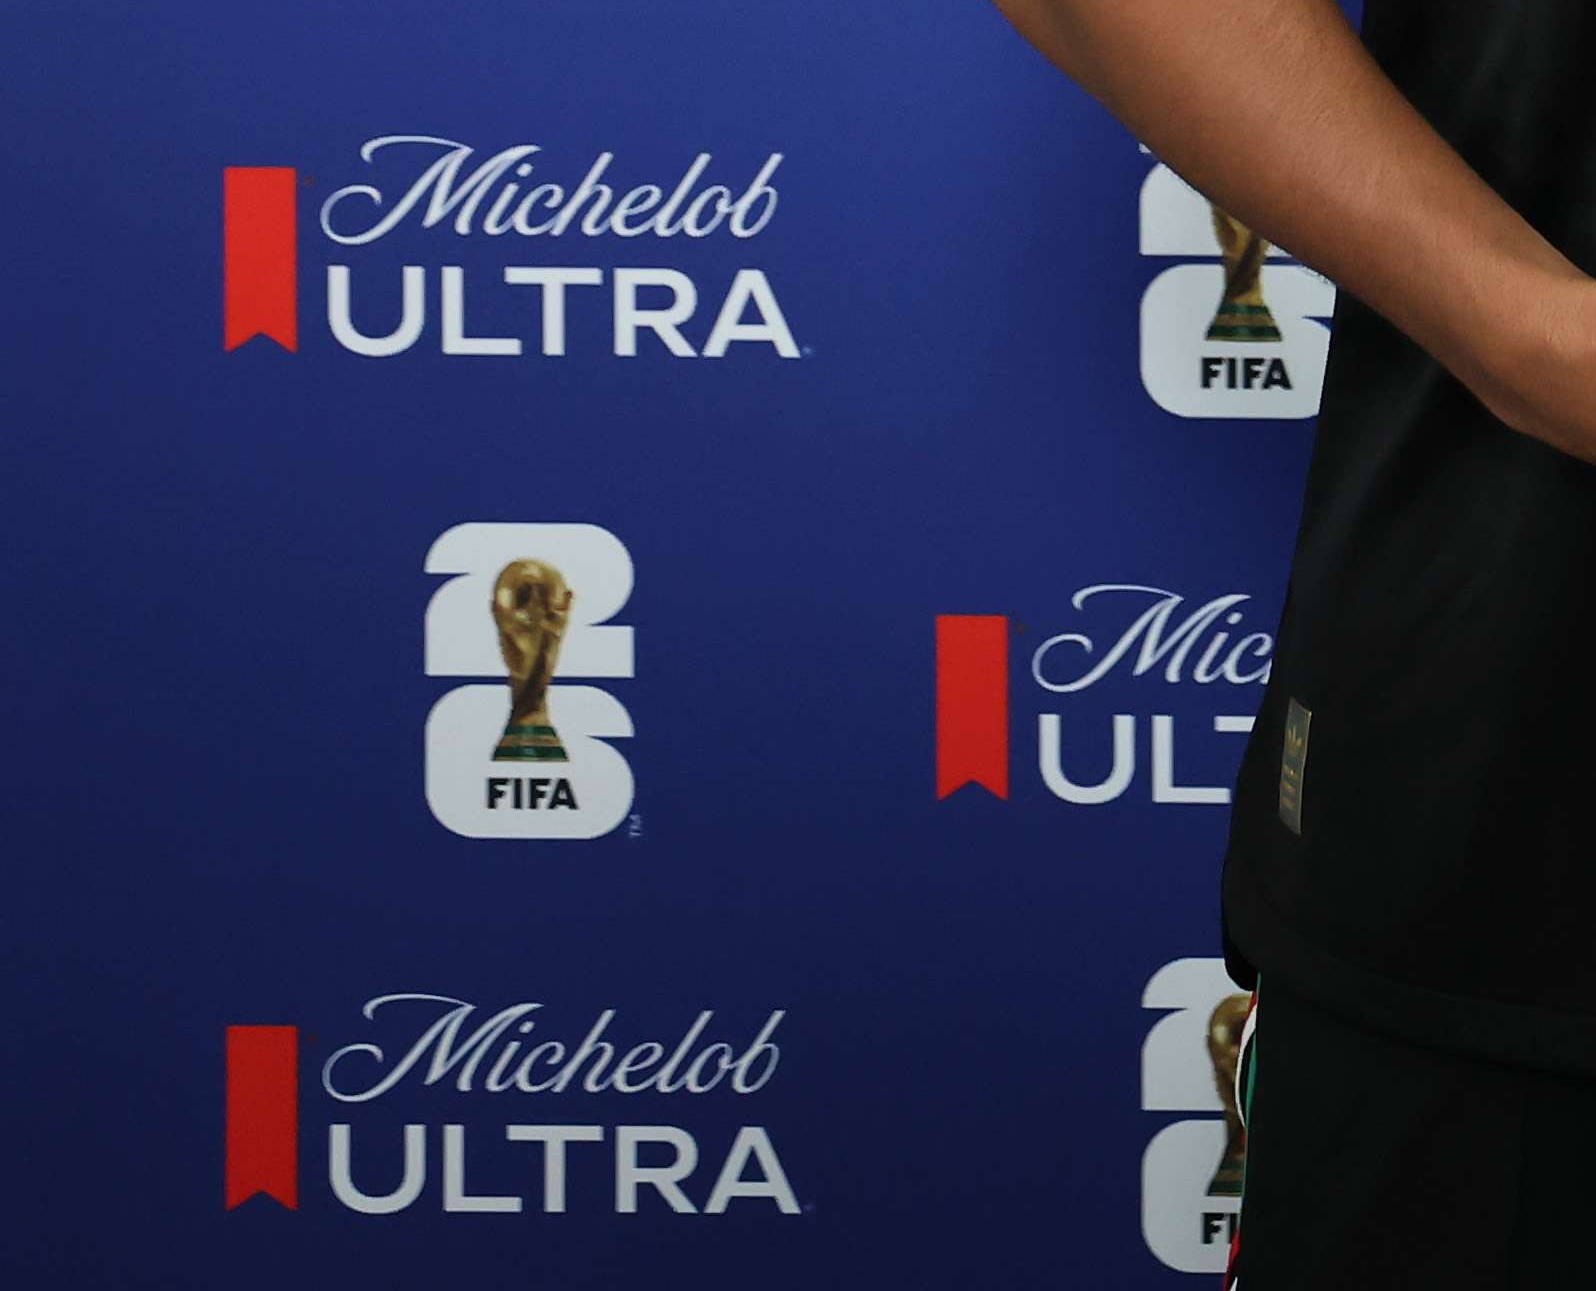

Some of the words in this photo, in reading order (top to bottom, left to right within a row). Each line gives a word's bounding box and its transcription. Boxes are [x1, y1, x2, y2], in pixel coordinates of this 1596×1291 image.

[320, 135, 784, 245] Michelob
[327, 265, 801, 359] ULTRA
[1200, 356, 1292, 391] FIFA
[487, 777, 579, 810] FIFA
[322, 993, 786, 1103] Michelob
[328, 1123, 802, 1215] ULTRA
[1202, 1211, 1238, 1245] FI
